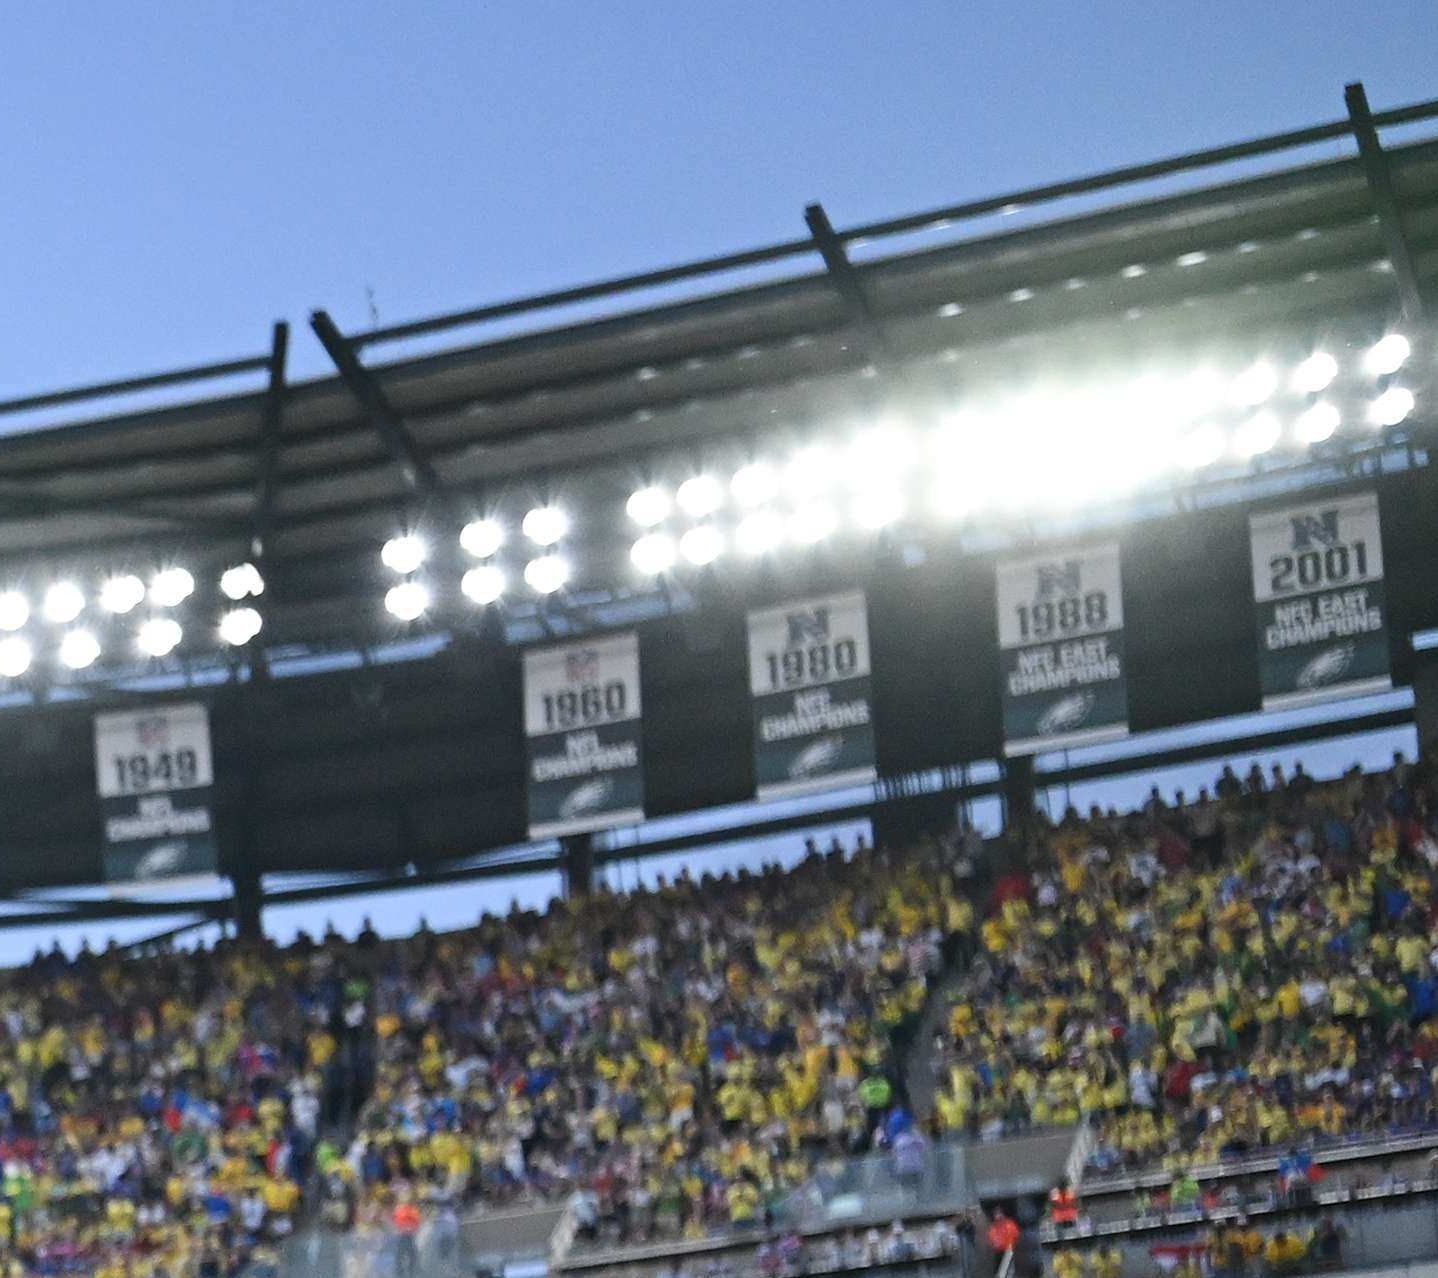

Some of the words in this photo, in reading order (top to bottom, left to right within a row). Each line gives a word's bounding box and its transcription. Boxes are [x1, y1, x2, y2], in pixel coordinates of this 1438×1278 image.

[1269, 541, 1369, 593] 2001
[1015, 591, 1109, 640] 1988
[1316, 590, 1368, 619] EAST
[1265, 607, 1382, 650] CHAMPIONS
[767, 639, 858, 688] 1980
[1008, 654, 1120, 696] CHAMPIONS
[542, 679, 627, 730] 1960
[113, 749, 197, 792] 1949
